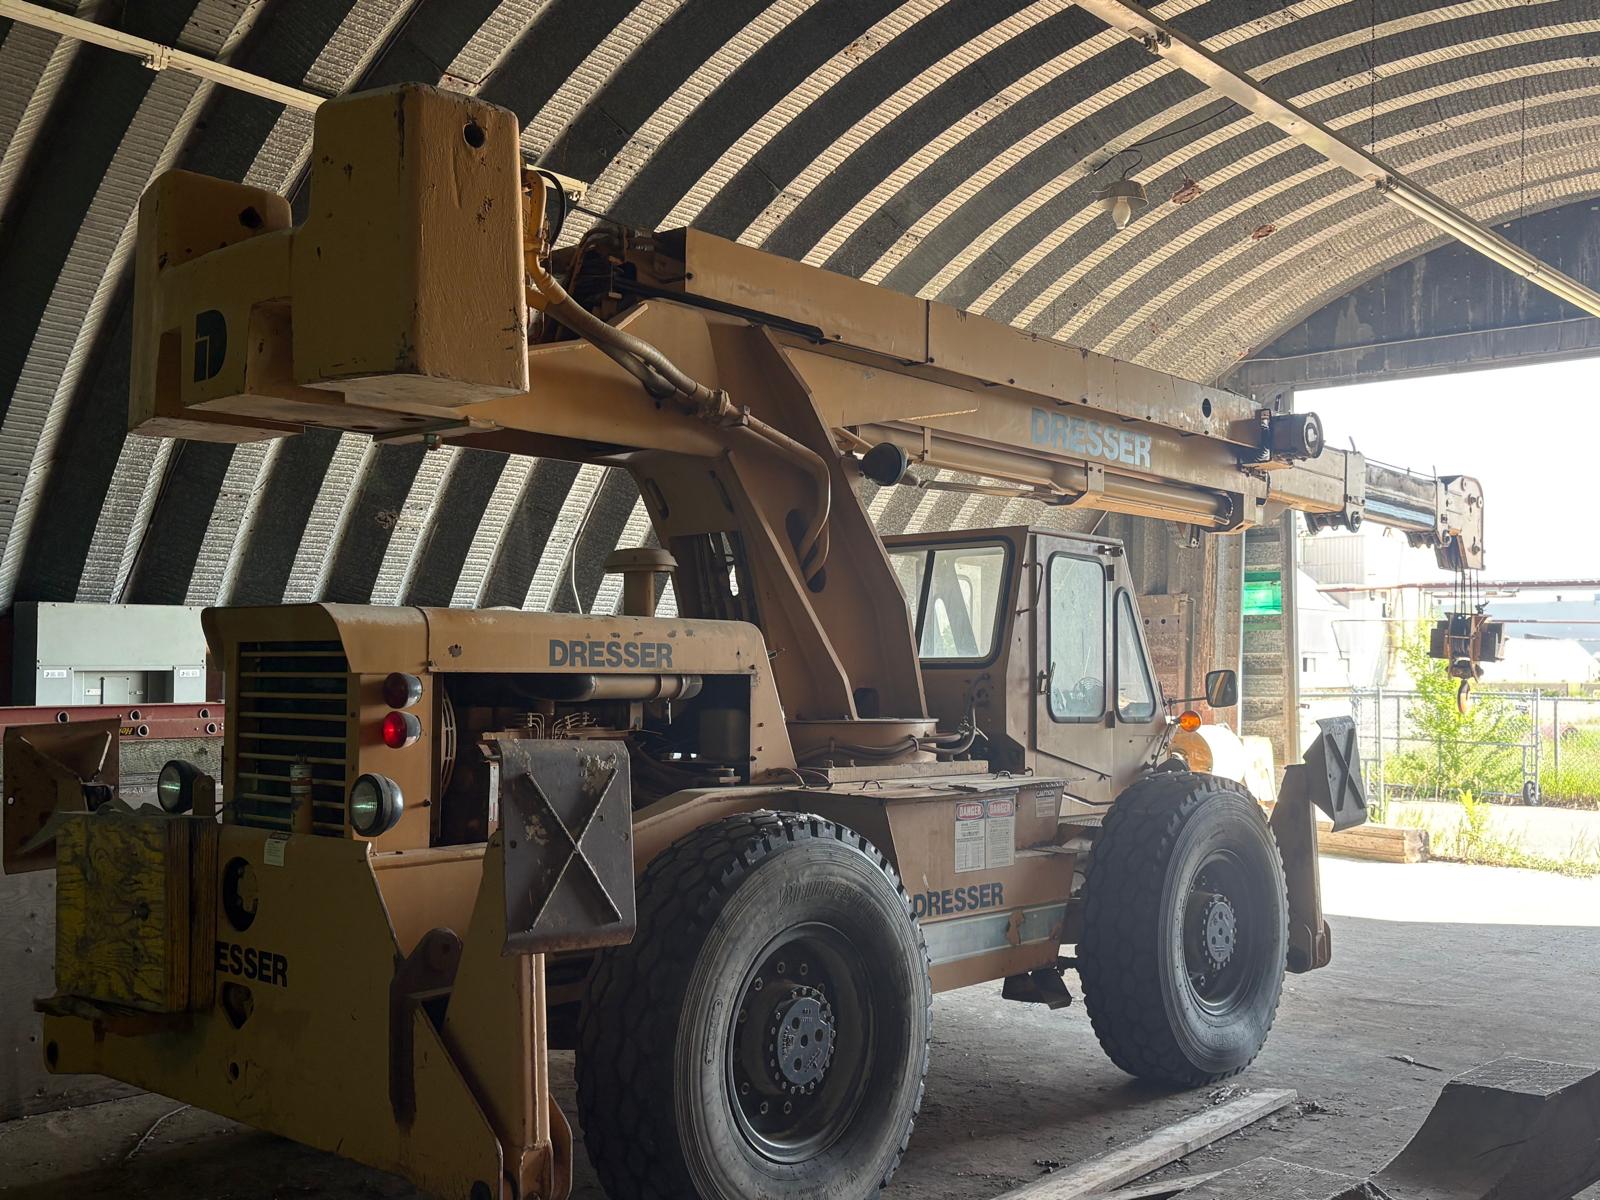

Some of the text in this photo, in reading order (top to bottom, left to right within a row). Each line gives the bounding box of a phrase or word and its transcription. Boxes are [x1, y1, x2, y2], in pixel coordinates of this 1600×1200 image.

[1031, 407, 1152, 468] DRESSER
[549, 639, 673, 668] DRESSER
[960, 804, 982, 817] DANGER
[990, 802, 1011, 815] DANGER
[912, 882, 1004, 918] DRESSER
[215, 940, 288, 988] ESSER
